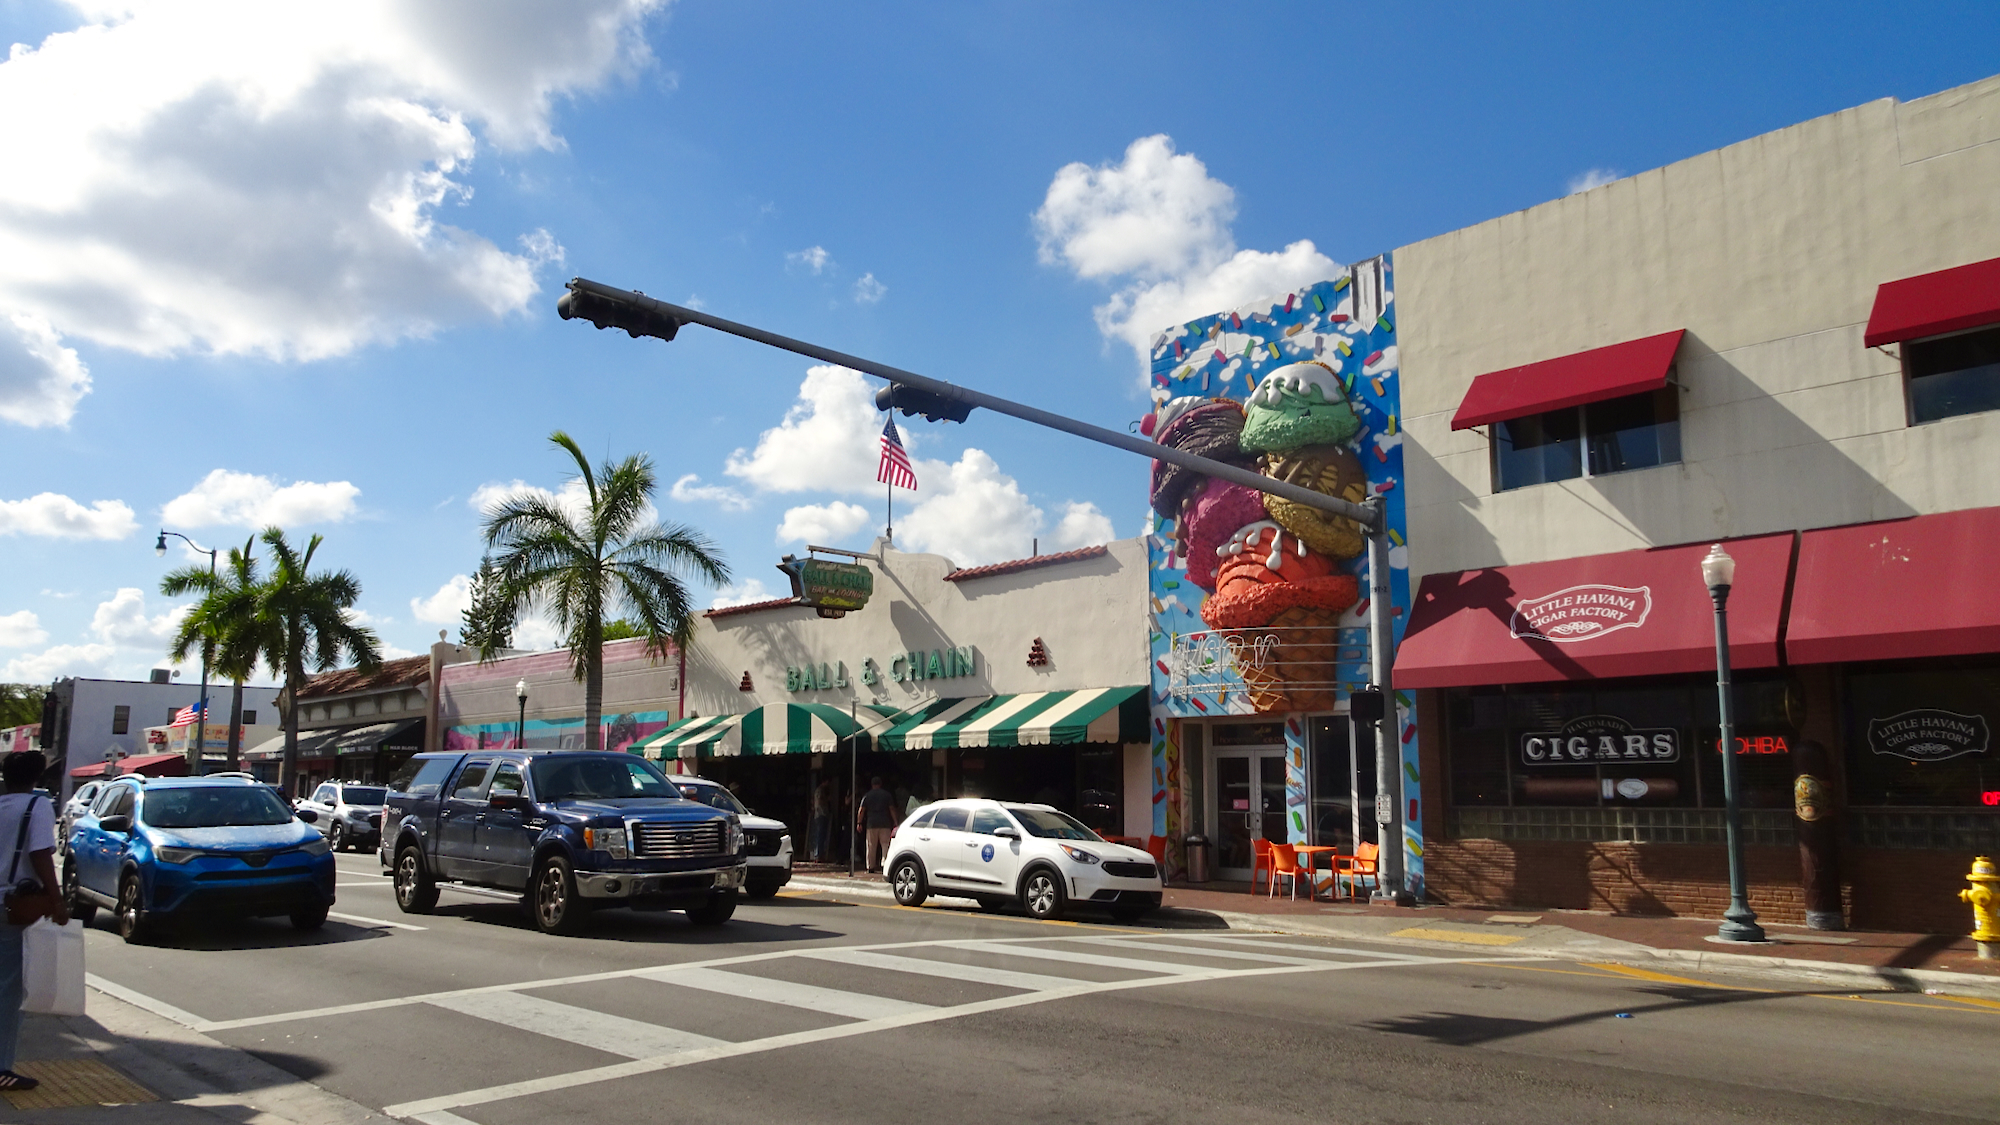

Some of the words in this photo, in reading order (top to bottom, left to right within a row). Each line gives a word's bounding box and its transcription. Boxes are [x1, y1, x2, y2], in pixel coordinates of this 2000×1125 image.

[803, 568, 831, 586] BALL
[841, 573, 872, 589] CHAIN
[811, 586, 825, 595] BAR
[836, 589, 867, 599] LOUNGE
[1523, 597, 1573, 620] LITTLE
[1576, 594, 1636, 611] HAVANA
[1530, 610, 1567, 629] CIGAR
[1570, 607, 1628, 621] FACTORY
[787, 661, 848, 692] BALL
[861, 656, 878, 685] &
[889, 645, 975, 683] CHAIN
[1567, 720, 1626, 734] HANDMADE
[1878, 719, 1918, 738] LITTLE
[1921, 718, 1975, 736] HAVANA
[1526, 734, 1675, 760] CIGARS
[1886, 731, 1918, 747] CIGAR
[1920, 730, 1971, 745] FACTORY
